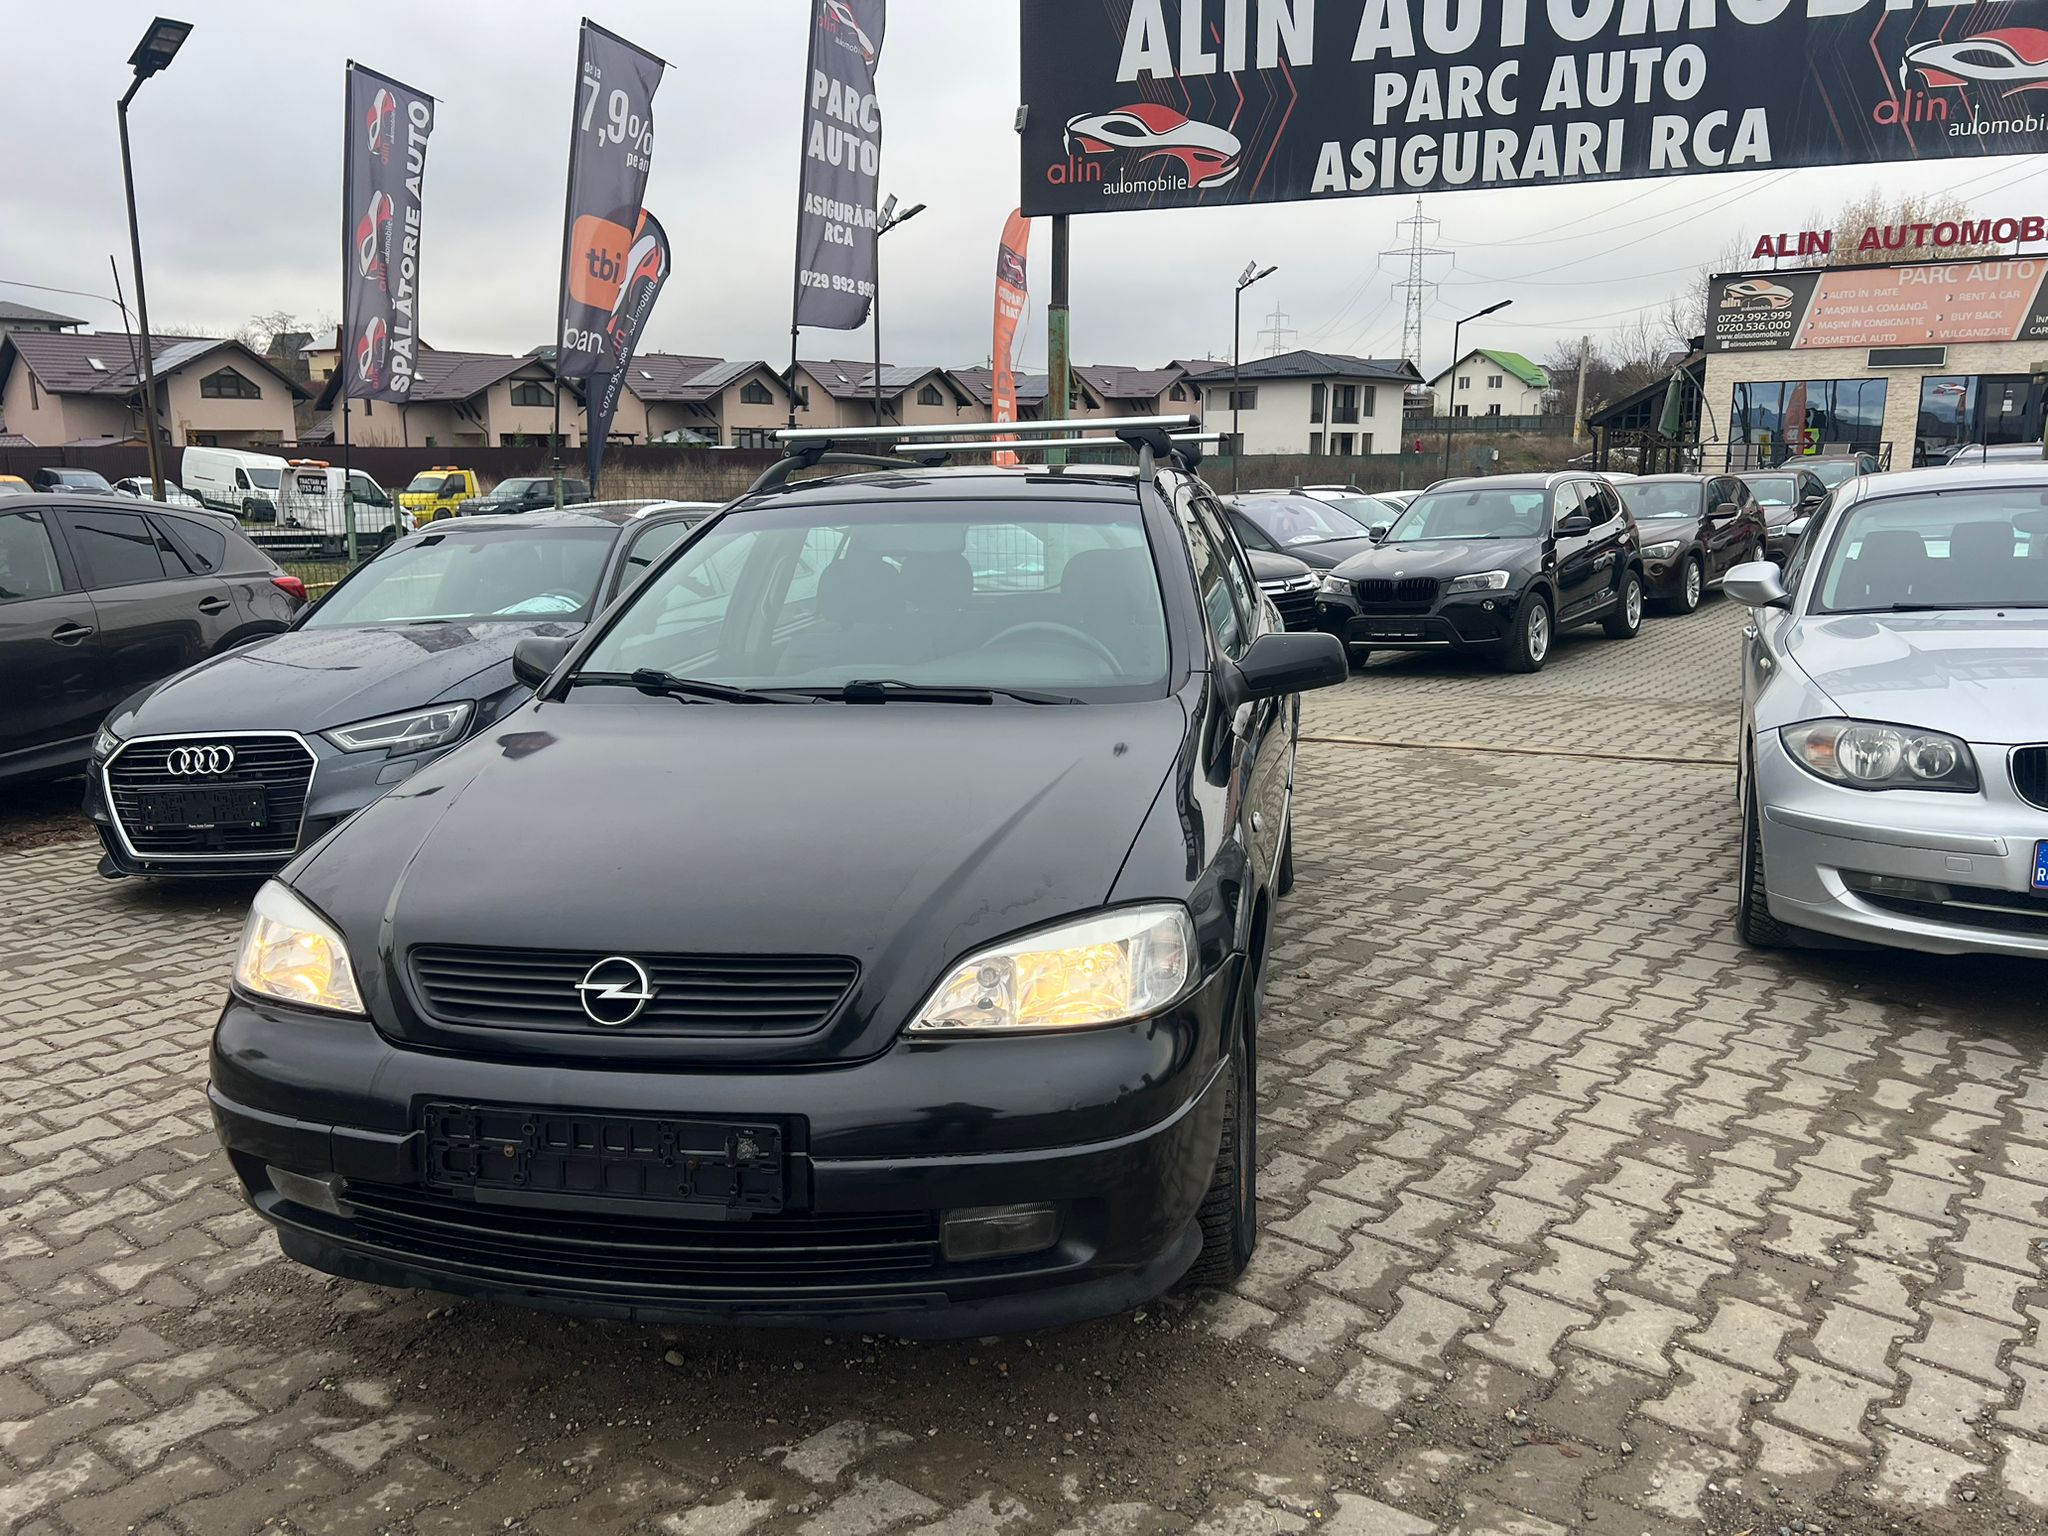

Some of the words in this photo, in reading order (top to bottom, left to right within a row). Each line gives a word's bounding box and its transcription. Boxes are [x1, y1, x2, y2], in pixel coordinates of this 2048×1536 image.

[1115, 0, 1315, 83] ALIN
[1373, 60, 1519, 126] PARC
[1541, 43, 1707, 112] AUTO
[812, 69, 879, 133] PARC
[1873, 89, 1948, 125] alin
[581, 76, 653, 155] 7,9%
[1949, 103, 2048, 136] automobi
[808, 119, 879, 177] AUTO
[1311, 119, 1625, 193] ASIGURARI
[1649, 107, 1772, 170] RCA
[626, 151, 638, 168] pe
[638, 155, 649, 173] an
[1047, 154, 1101, 185] alin
[805, 192, 876, 230] ASIGURĂRI
[389, 206, 421, 392] SPĂLĂTORIE
[405, 100, 430, 201] AUTO
[824, 221, 854, 247] RCA
[1751, 230, 1833, 259] ALIN
[1858, 215, 2048, 252] AUTOMOB
[586, 248, 621, 284] tbi
[1898, 266, 1960, 286] PARC
[1966, 260, 2036, 281] AUTO
[801, 269, 829, 289] 0729
[832, 274, 855, 294] 992
[857, 280, 875, 298] 999
[1827, 290, 1856, 299] AUTO
[1873, 287, 1900, 297] RATE
[1958, 292, 1987, 301] RENT
[1989, 291, 1997, 300] A
[1999, 290, 2021, 300] CAR
[1720, 297, 1741, 309] alin
[1861, 305, 1874, 314] LA
[1876, 300, 1929, 313] COMANDĂ
[1951, 312, 1973, 321] BUY
[1975, 310, 2003, 320] BACK
[1716, 321, 1791, 333] 0720.536.000
[1717, 311, 1792, 323] 0729.992.999
[563, 319, 604, 354] ban
[1715, 330, 1790, 340] www.alinautomobile.ro
[1812, 333, 1867, 345] COSMETICĂ
[1868, 333, 1897, 343] AUTO
[1939, 327, 2011, 338] VULCANIZARE
[602, 385, 616, 410] 0729
[2036, 867, 2048, 881] R
